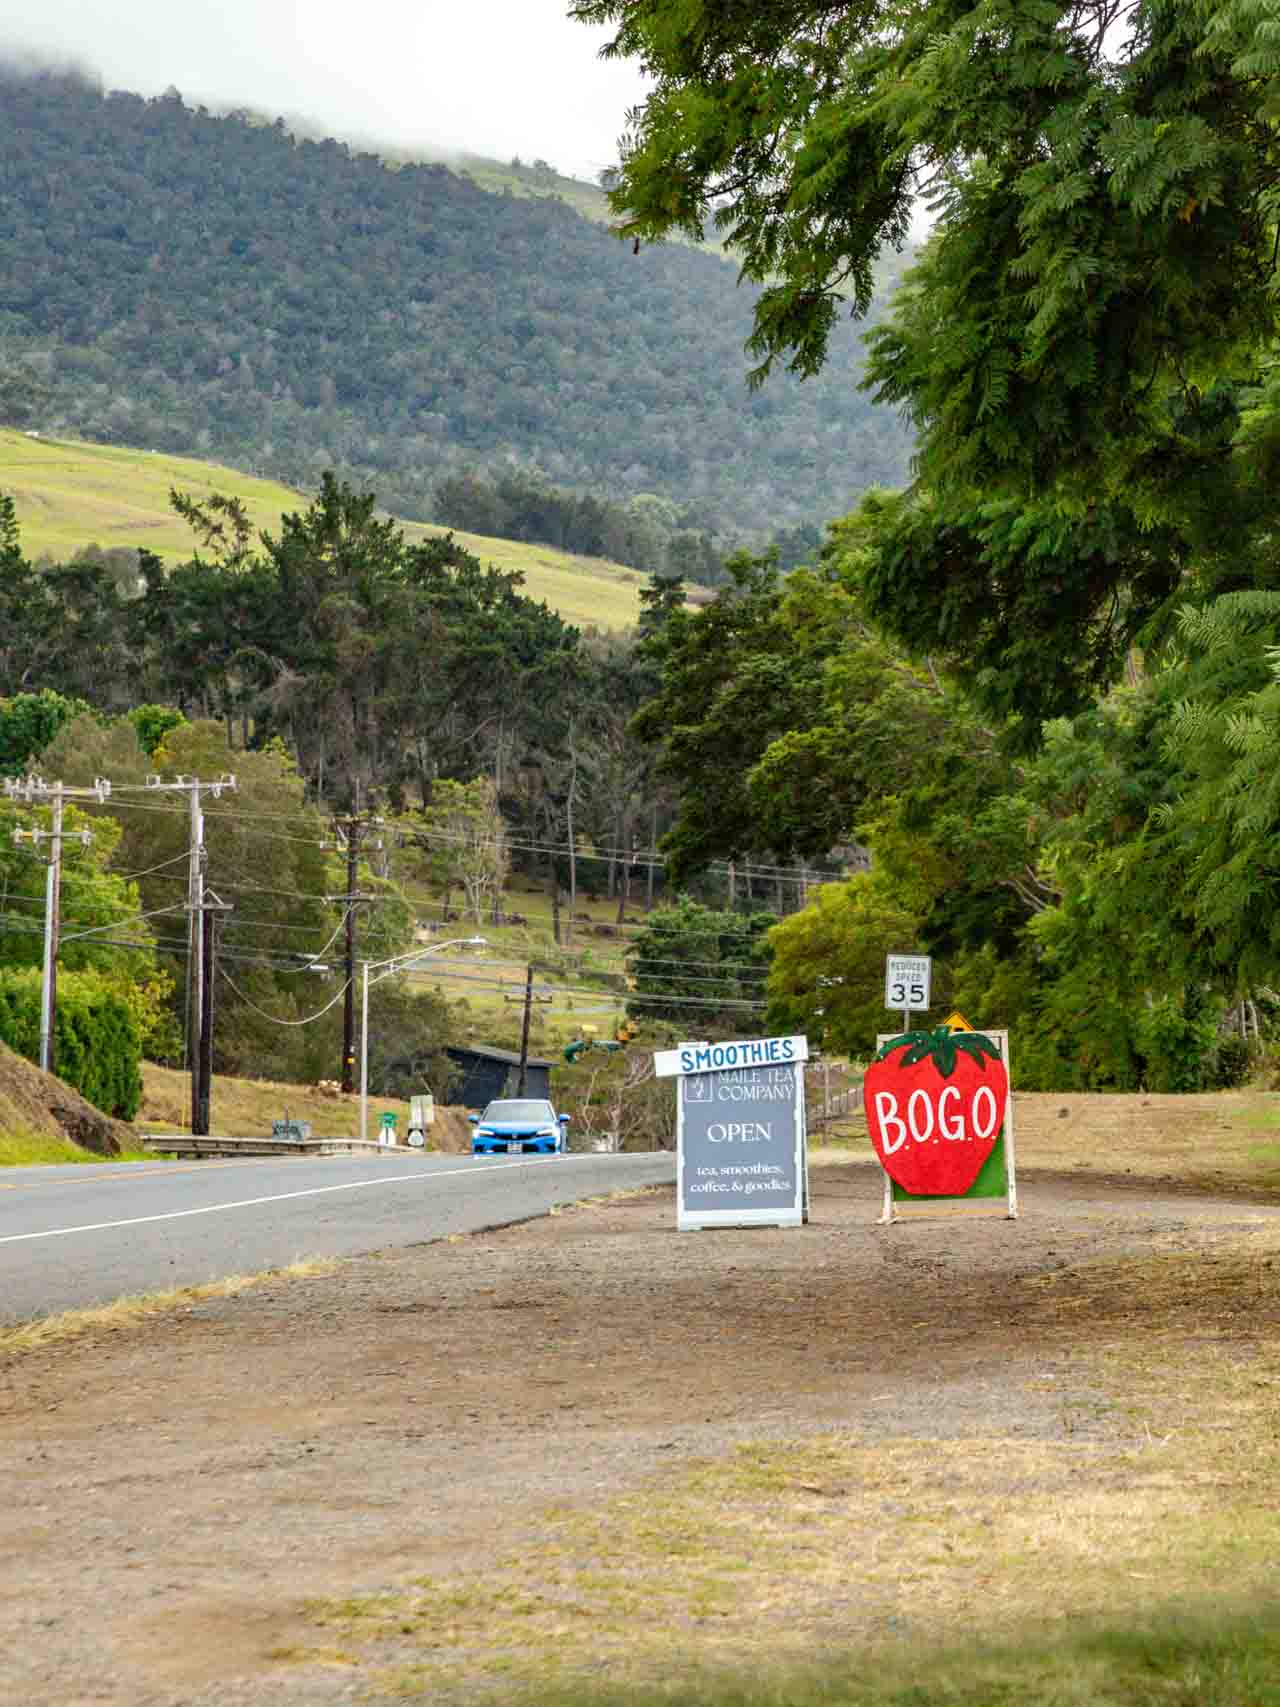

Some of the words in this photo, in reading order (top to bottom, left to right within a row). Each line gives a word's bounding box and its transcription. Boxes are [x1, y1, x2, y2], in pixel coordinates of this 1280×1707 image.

[890, 961, 926, 971] REDUCED
[895, 972, 921, 982] SPEED
[891, 983, 925, 1003] 35
[680, 1038, 794, 1072] SMOOTHIES
[719, 1069, 762, 1083] MAILE
[767, 1067, 793, 1083] TEA
[718, 1084, 794, 1101] COMPANY
[707, 1122, 773, 1142] OPEN
[731, 1181, 743, 1193] &
